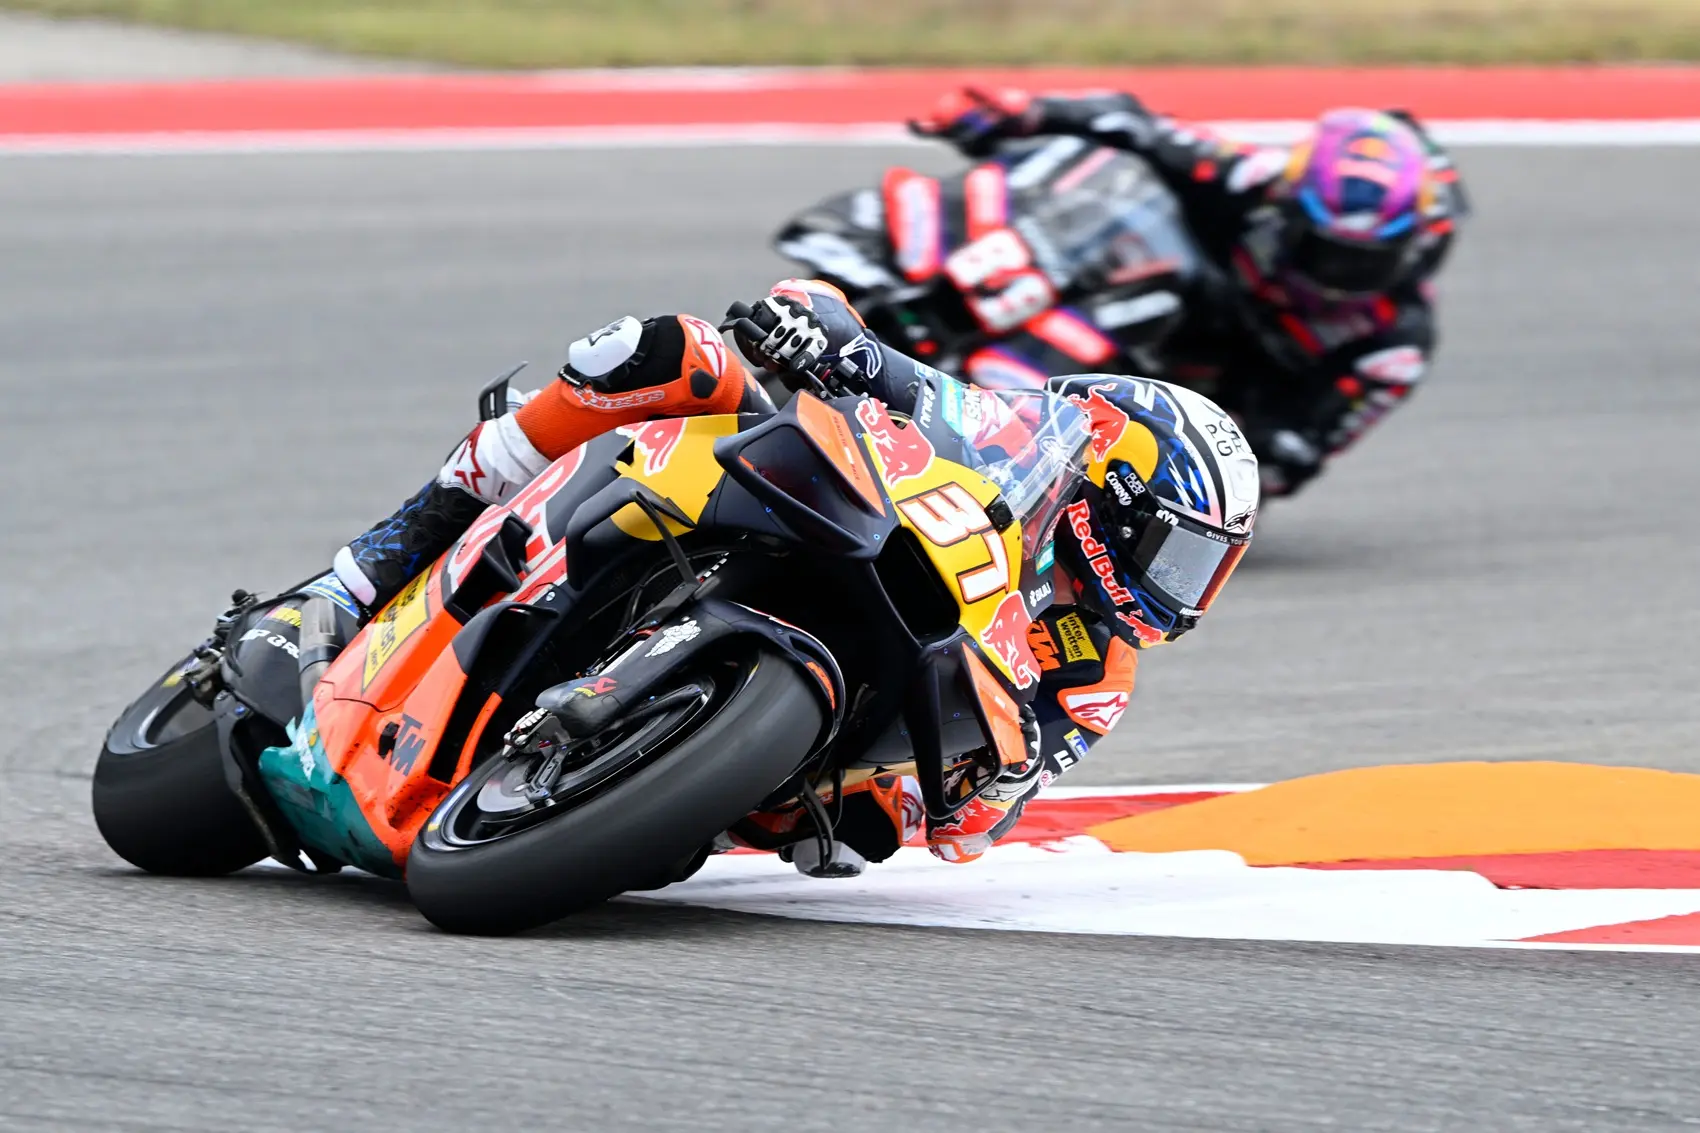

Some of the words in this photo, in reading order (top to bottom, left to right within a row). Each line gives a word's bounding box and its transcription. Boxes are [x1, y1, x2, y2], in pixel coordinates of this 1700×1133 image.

[1105, 471, 1132, 506] CORNY
[1066, 498, 1107, 560] Red
[1089, 554, 1136, 607] Bull
